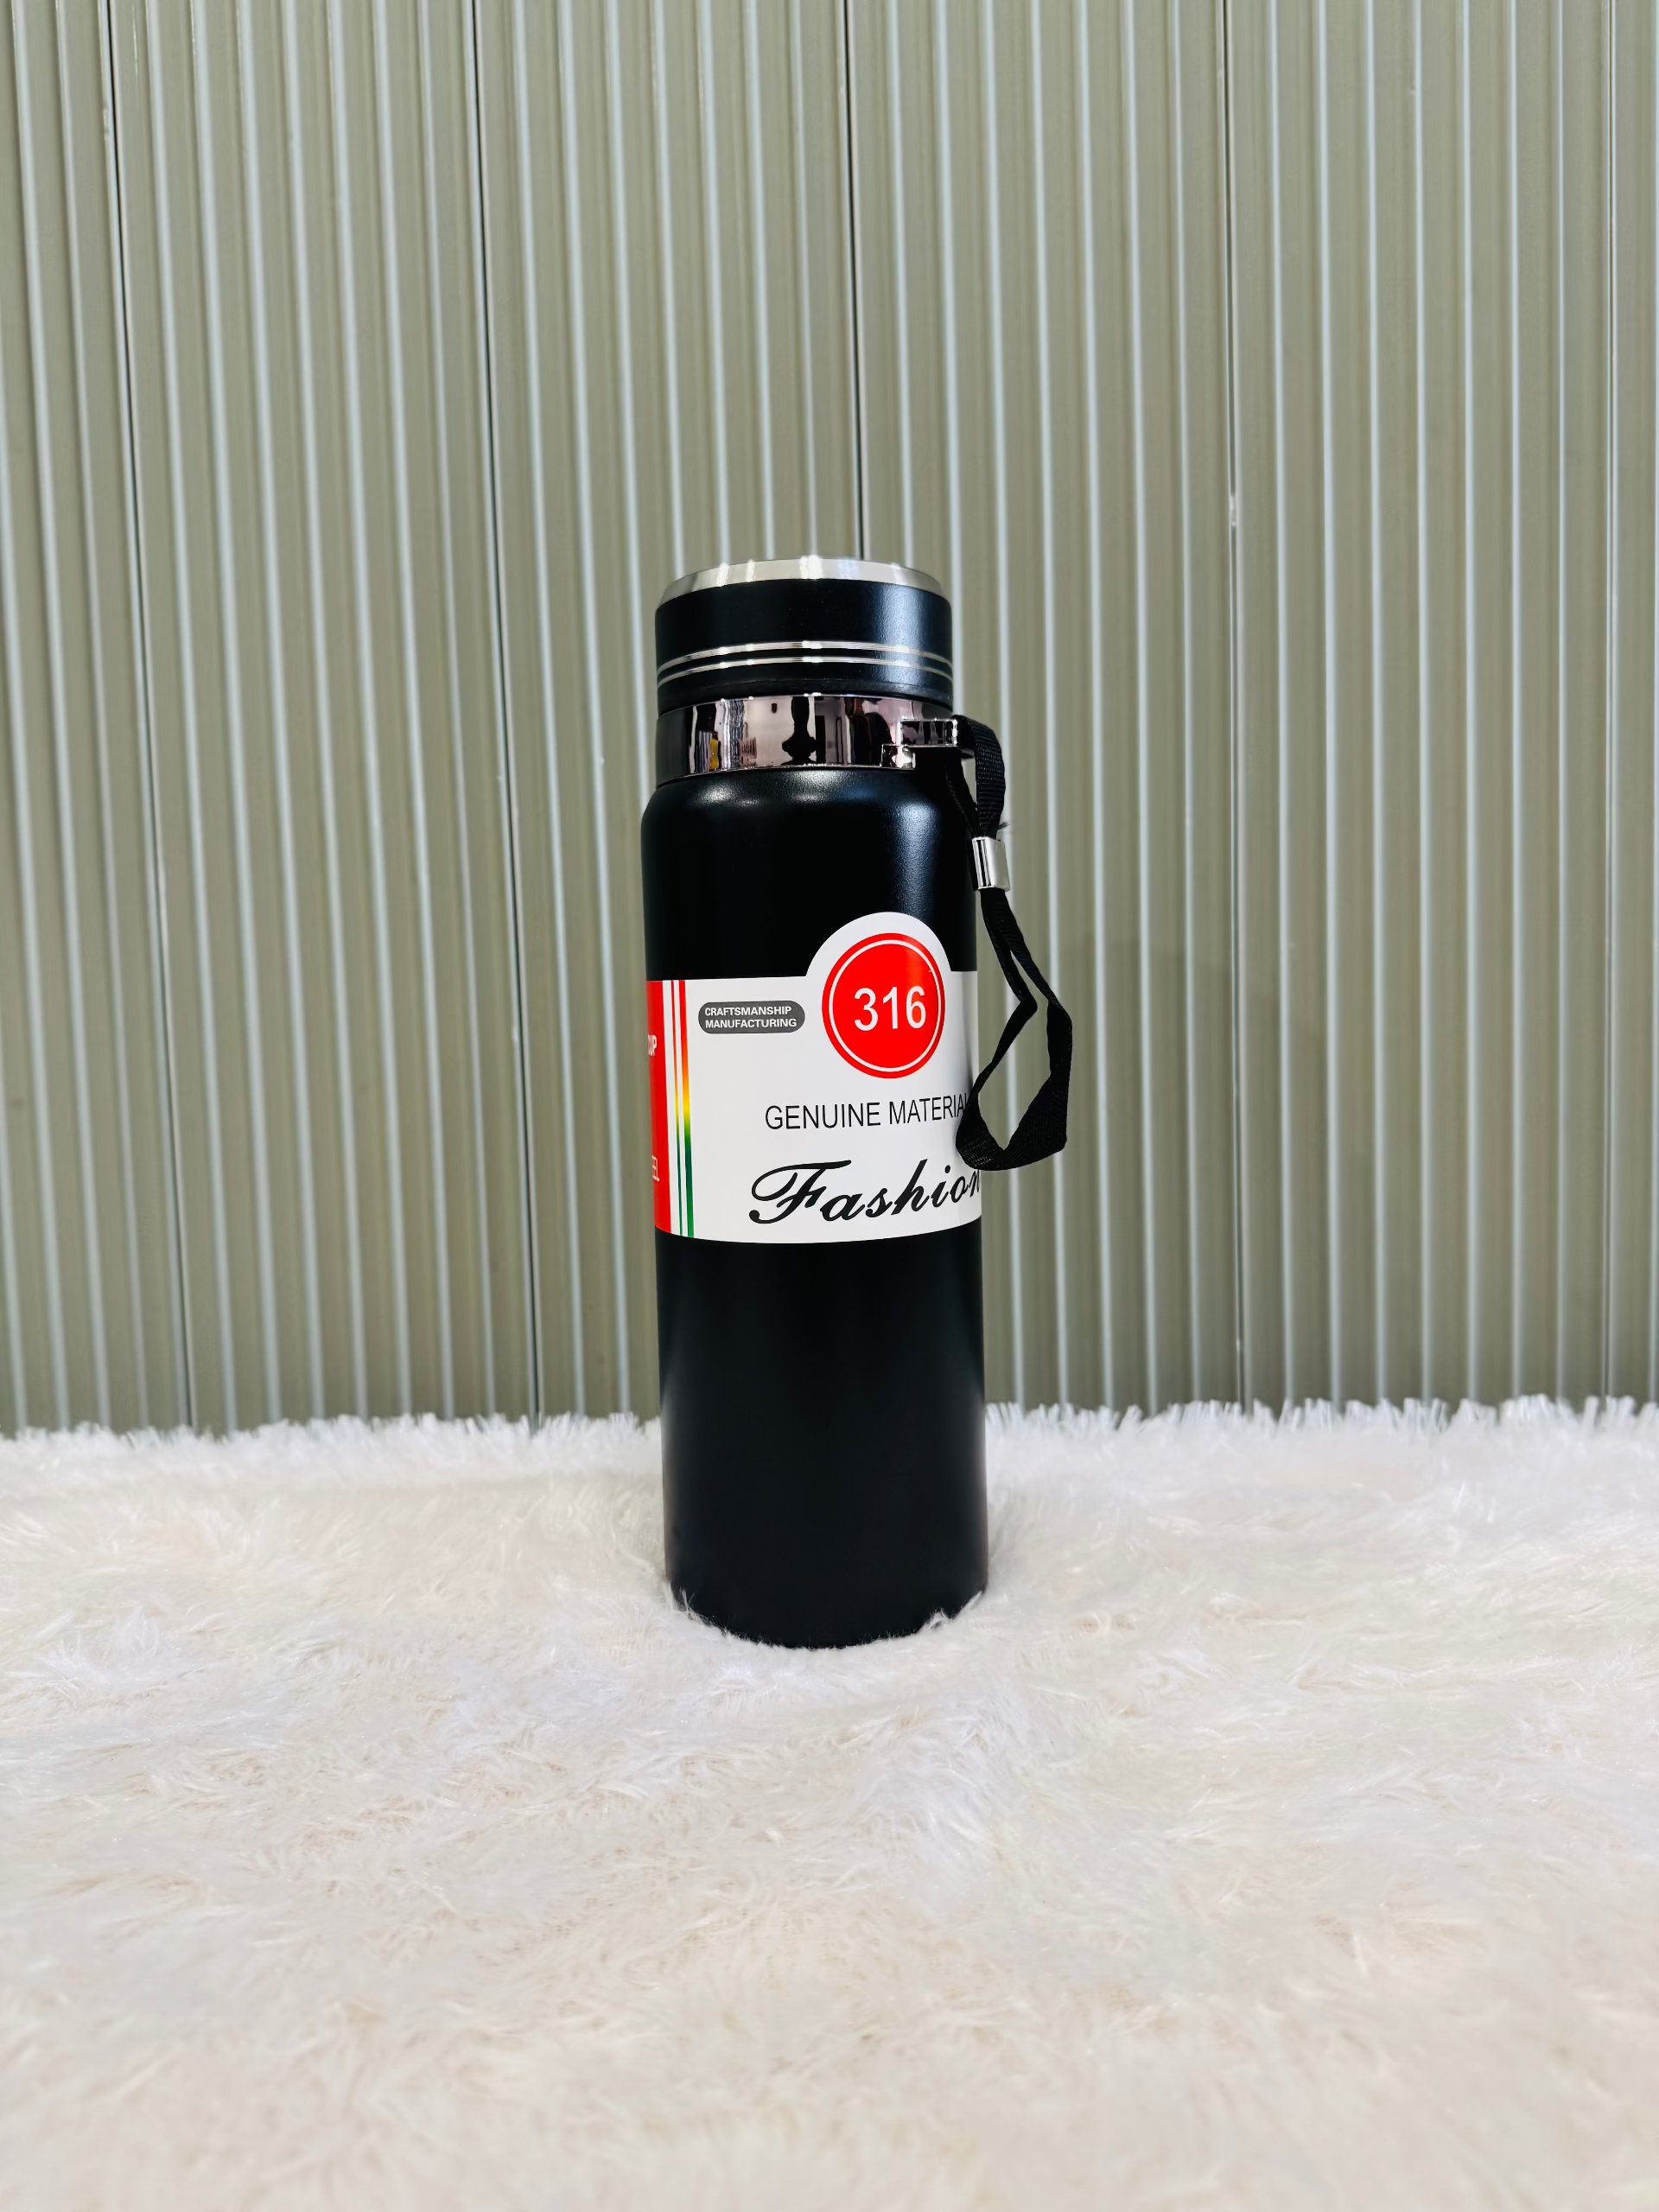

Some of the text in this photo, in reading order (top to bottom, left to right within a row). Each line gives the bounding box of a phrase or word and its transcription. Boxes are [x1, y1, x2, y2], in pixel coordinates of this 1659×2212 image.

[704, 1006, 792, 1016] CRAFTSMANSHIP
[854, 985, 927, 1032] 316
[705, 1018, 798, 1028] MANUFACTURING
[765, 1102, 881, 1130] GENUINE
[748, 1158, 980, 1224] Fashion
